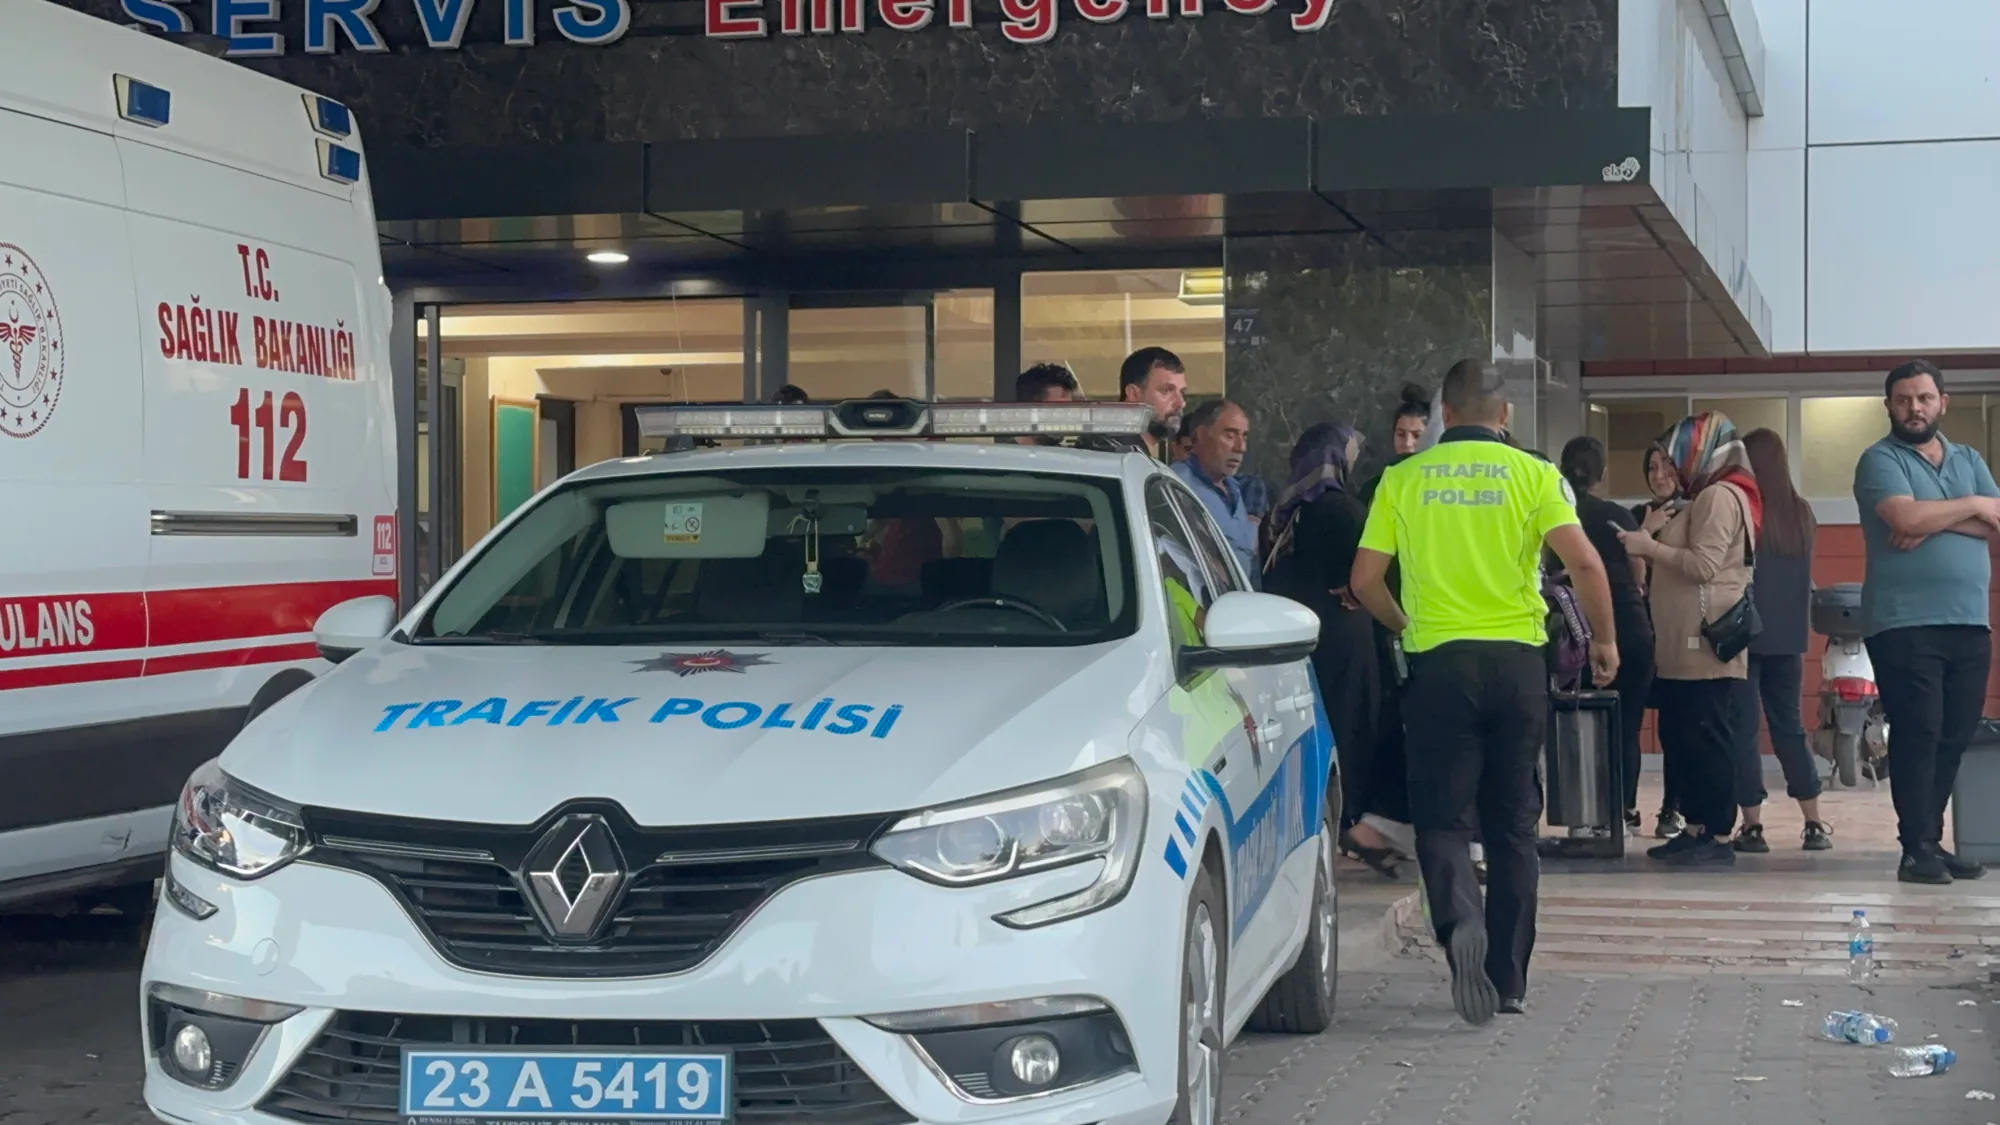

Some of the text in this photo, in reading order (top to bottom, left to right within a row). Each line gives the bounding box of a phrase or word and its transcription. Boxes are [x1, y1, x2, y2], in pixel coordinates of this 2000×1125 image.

[237, 244, 280, 302] T.C.
[158, 293, 356, 381] SAĞLIK BAKANLIĞI
[1232, 318, 1254, 333] 47
[230, 387, 308, 483] 112
[376, 522, 392, 550] 112
[373, 696, 904, 739] TRAFİK POLİSİ
[423, 1060, 711, 1110] 23 A 5419
